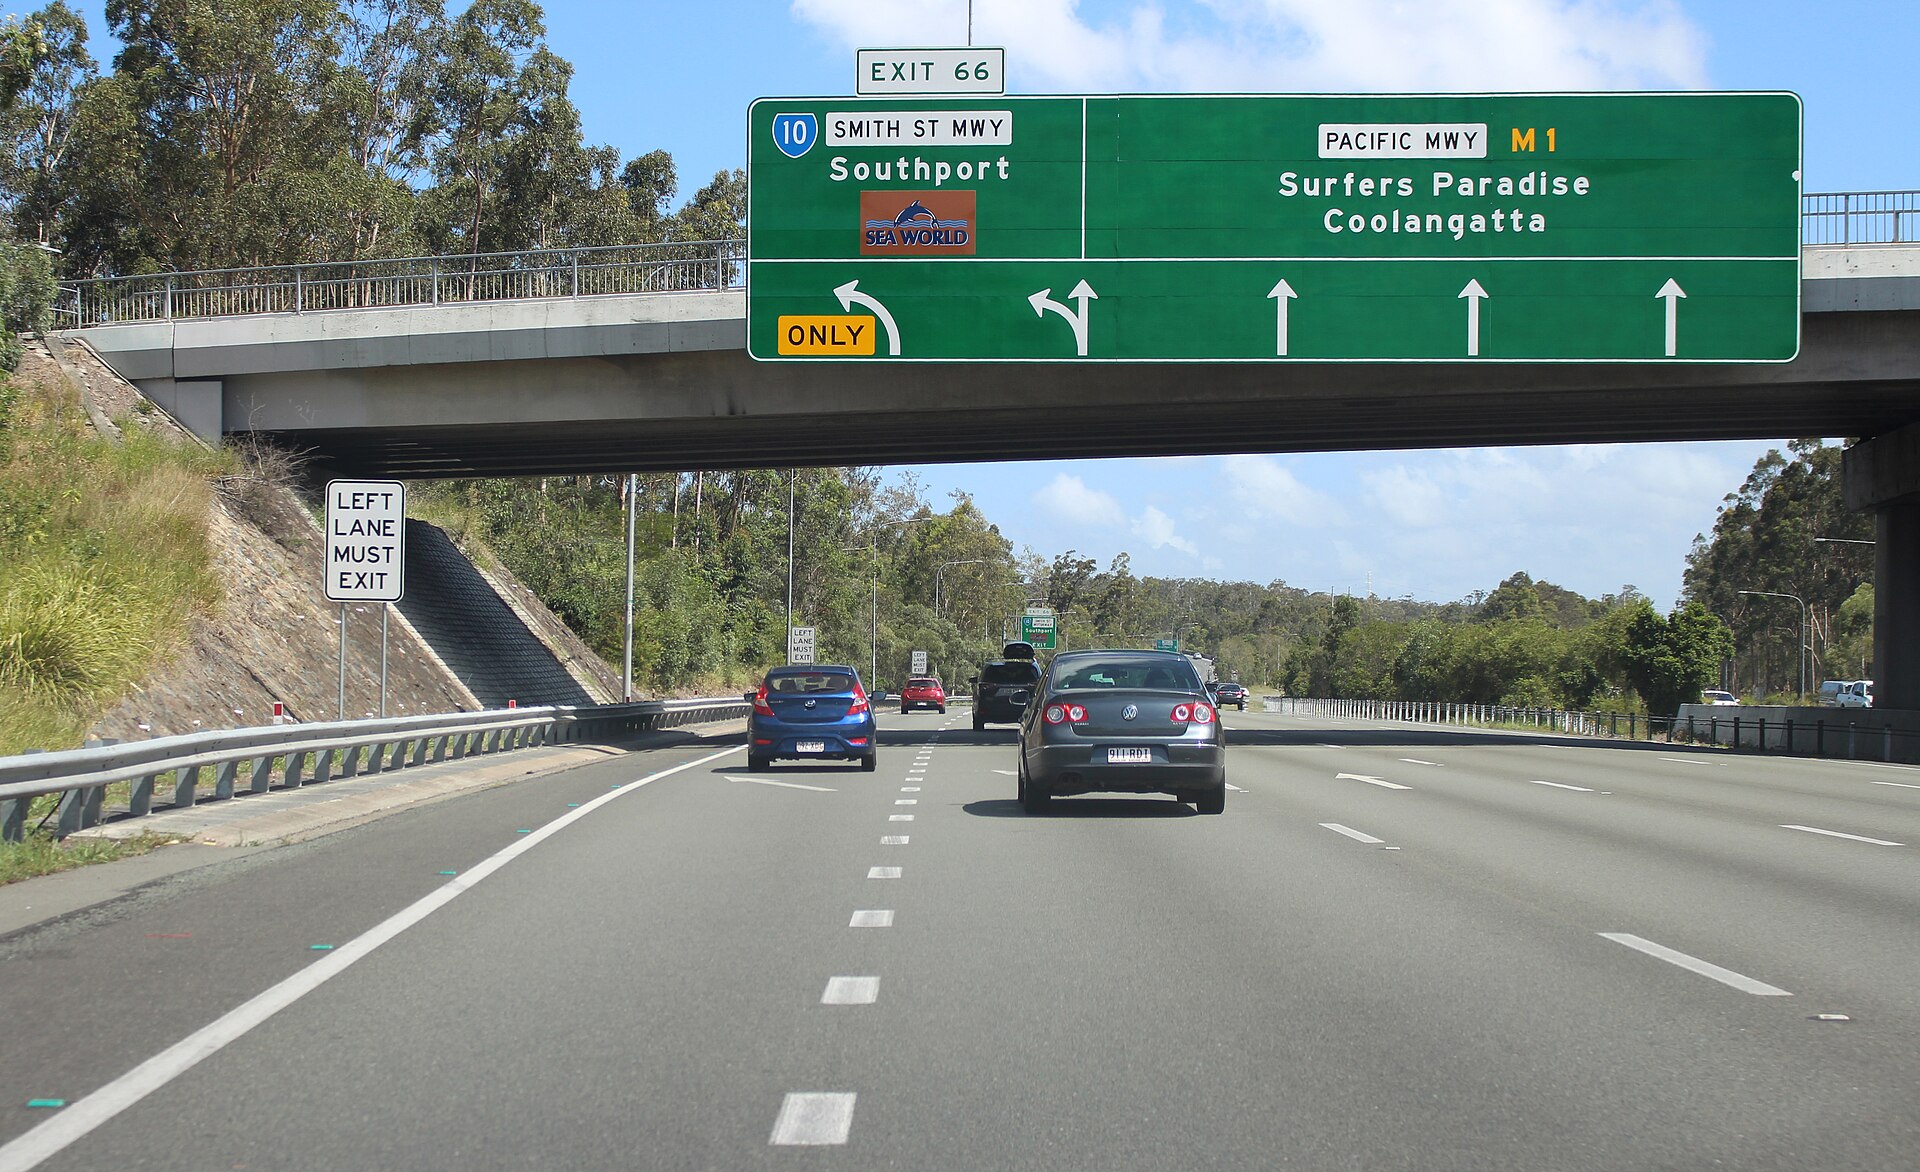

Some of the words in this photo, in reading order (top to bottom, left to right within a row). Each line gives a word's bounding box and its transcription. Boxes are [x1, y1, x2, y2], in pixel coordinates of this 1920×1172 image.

[871, 61, 935, 82] EXIT
[954, 61, 989, 81] 66
[782, 120, 807, 146] 10
[834, 119, 900, 139] SMITH
[913, 119, 938, 138] ST
[952, 118, 1003, 138] MWY
[1325, 131, 1412, 151] PACIFIC
[1425, 131, 1478, 150] MWY
[829, 155, 1010, 187] Southport
[1278, 171, 1414, 197] Surfers
[1433, 171, 1590, 197] Paradise
[1323, 208, 1546, 241] Coolangatta
[866, 230, 898, 246] SEA
[900, 230, 969, 246] WORLD
[787, 324, 865, 346] ONLY
[337, 492, 394, 510] LEFT
[334, 518, 395, 537] LANE
[334, 545, 395, 564] MUST
[339, 571, 388, 590] EXIT
